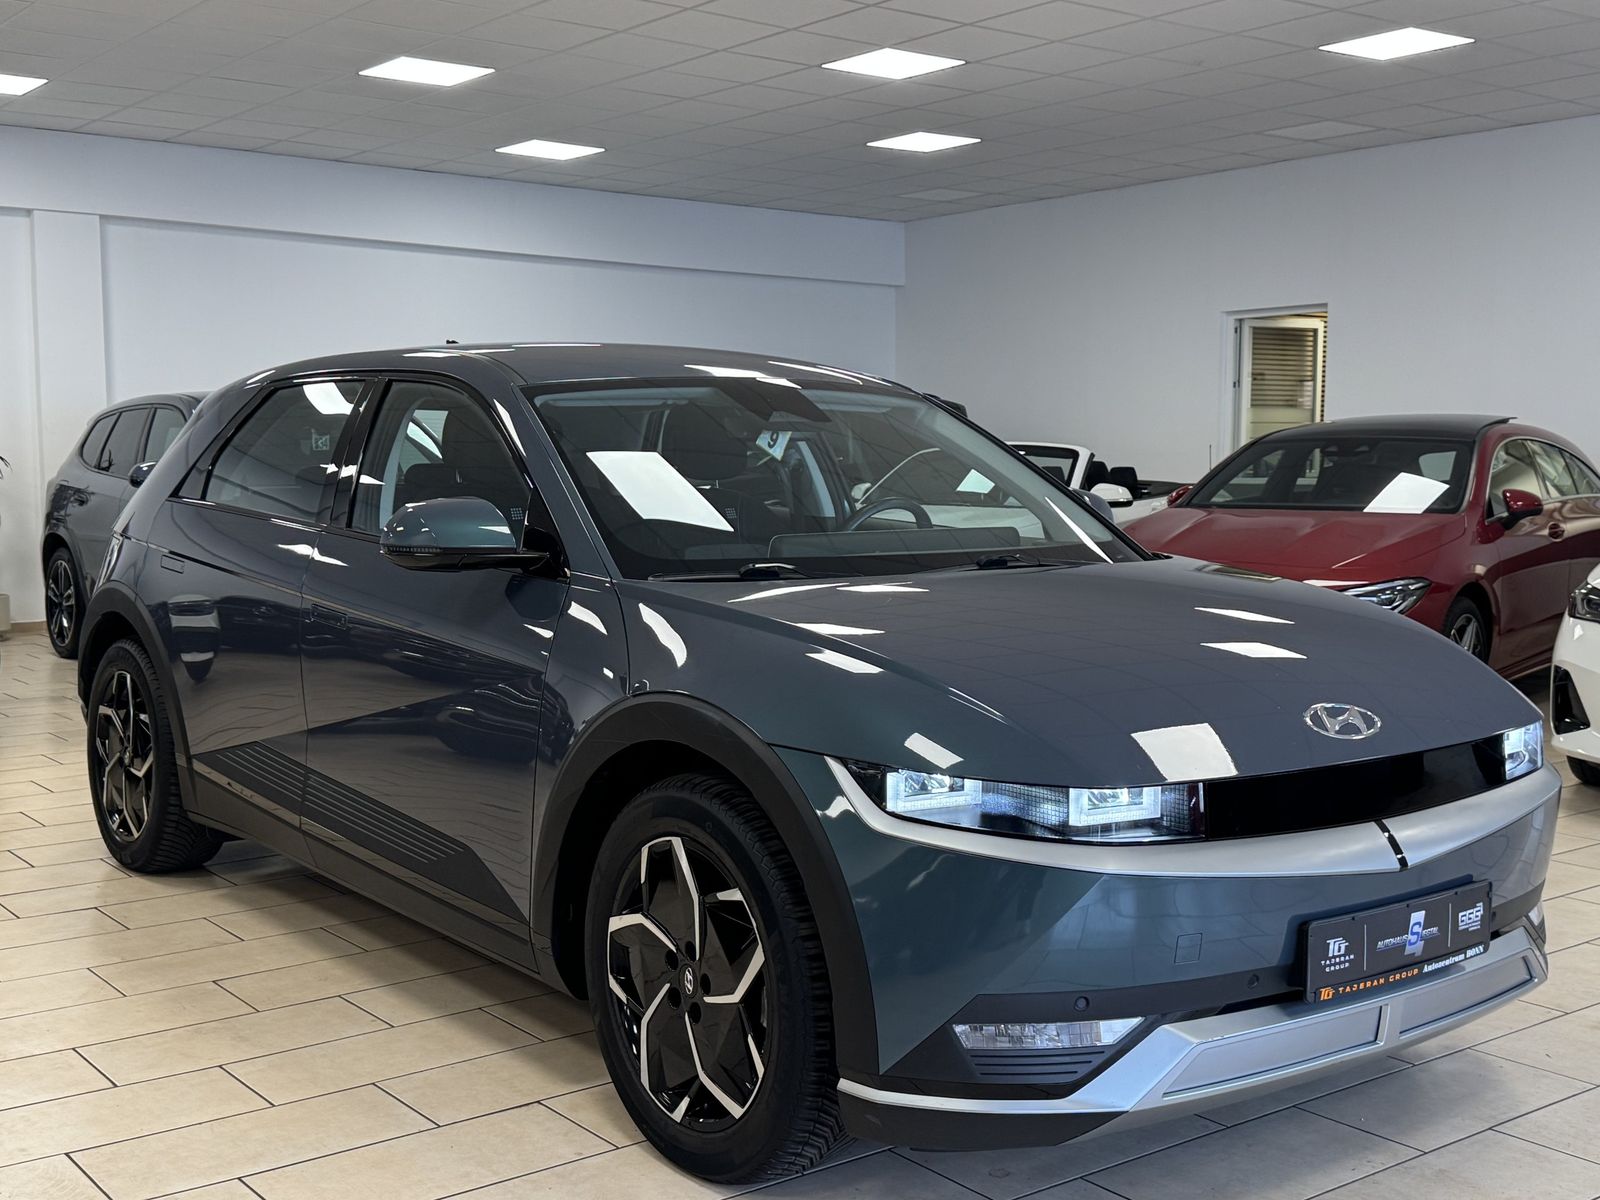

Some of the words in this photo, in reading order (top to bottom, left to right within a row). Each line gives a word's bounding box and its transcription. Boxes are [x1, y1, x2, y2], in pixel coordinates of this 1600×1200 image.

[1376, 934, 1409, 949] AUTOHAUS
[1320, 954, 1355, 966] TAJERAN
[1325, 963, 1350, 973] GROUP
[1338, 977, 1385, 994] TAJERAN
[1388, 968, 1419, 982] GROUP
[1423, 953, 1465, 974] Autozentrum
[1466, 944, 1485, 958] BONN
